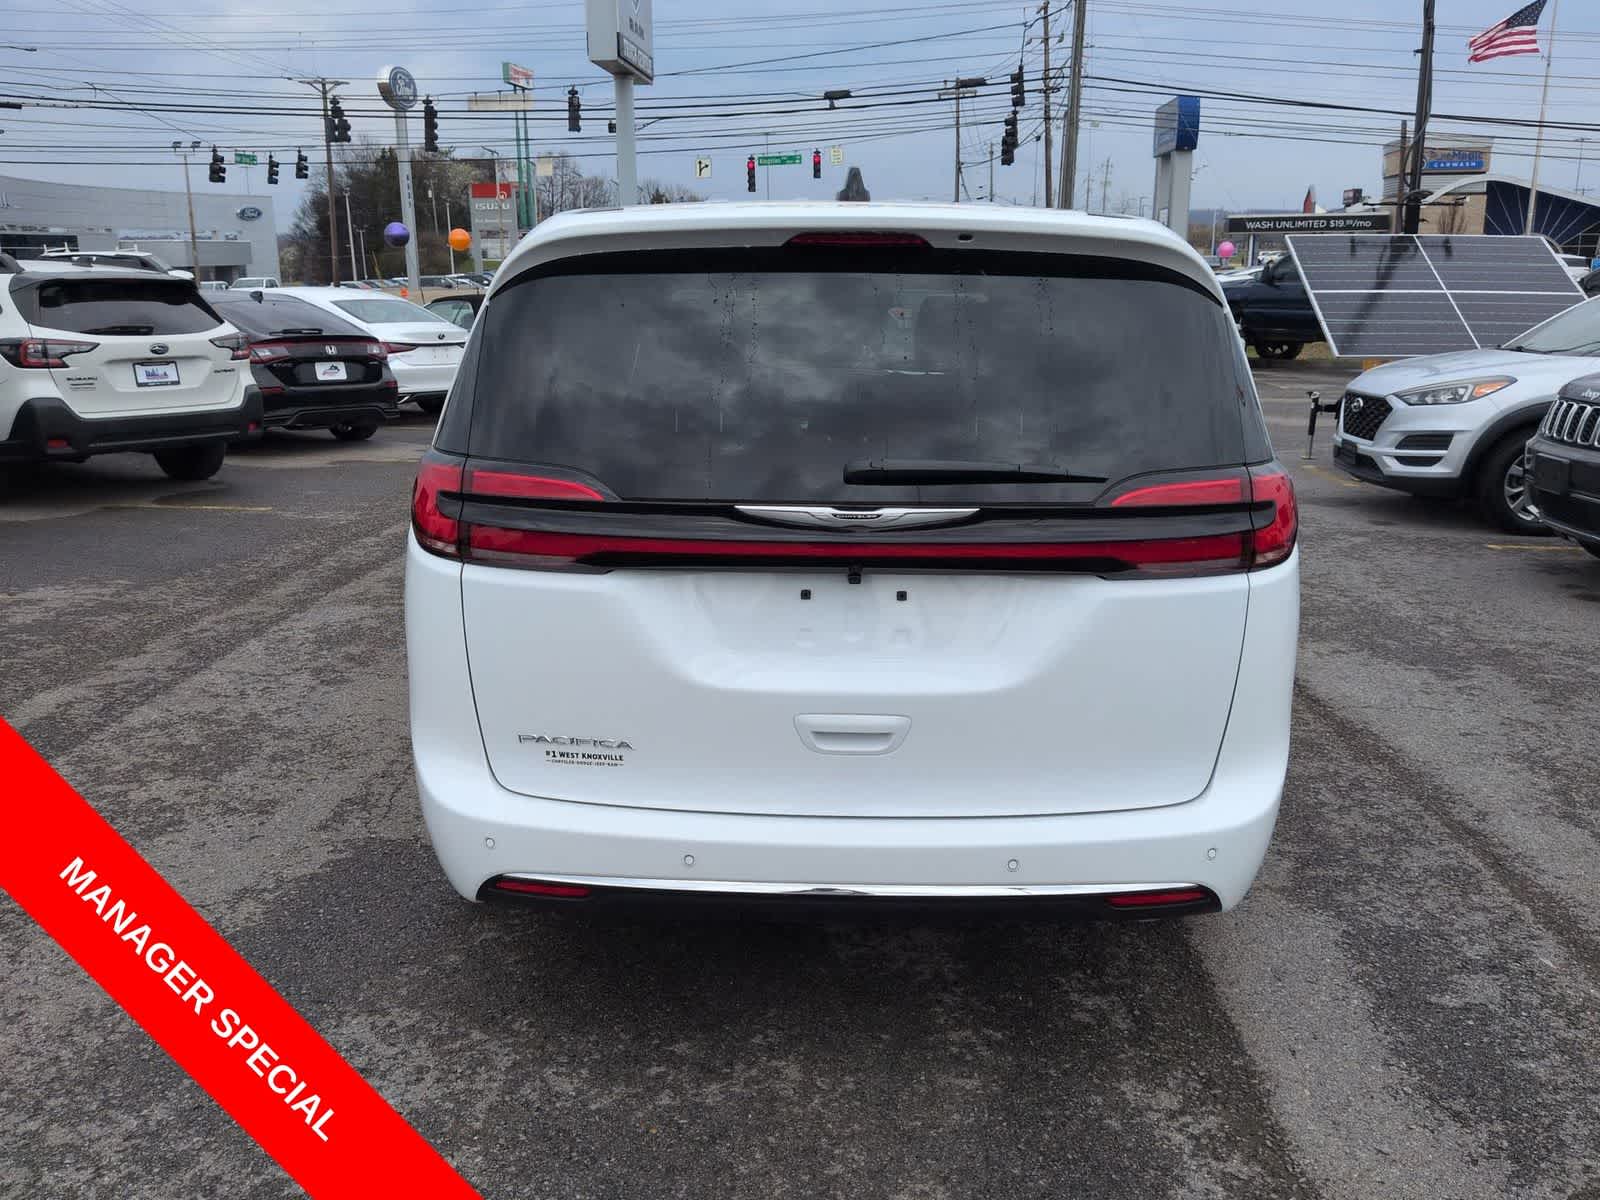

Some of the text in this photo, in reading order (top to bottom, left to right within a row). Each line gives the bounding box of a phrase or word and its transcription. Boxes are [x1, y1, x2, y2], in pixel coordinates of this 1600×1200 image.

[475, 201, 510, 210] ISUZU
[1245, 220, 1274, 230] WASH
[1275, 219, 1327, 229] UNLIMITED
[518, 734, 634, 750] PACIFICA
[558, 751, 580, 760] WEST
[581, 752, 624, 762] KNOXVILLE
